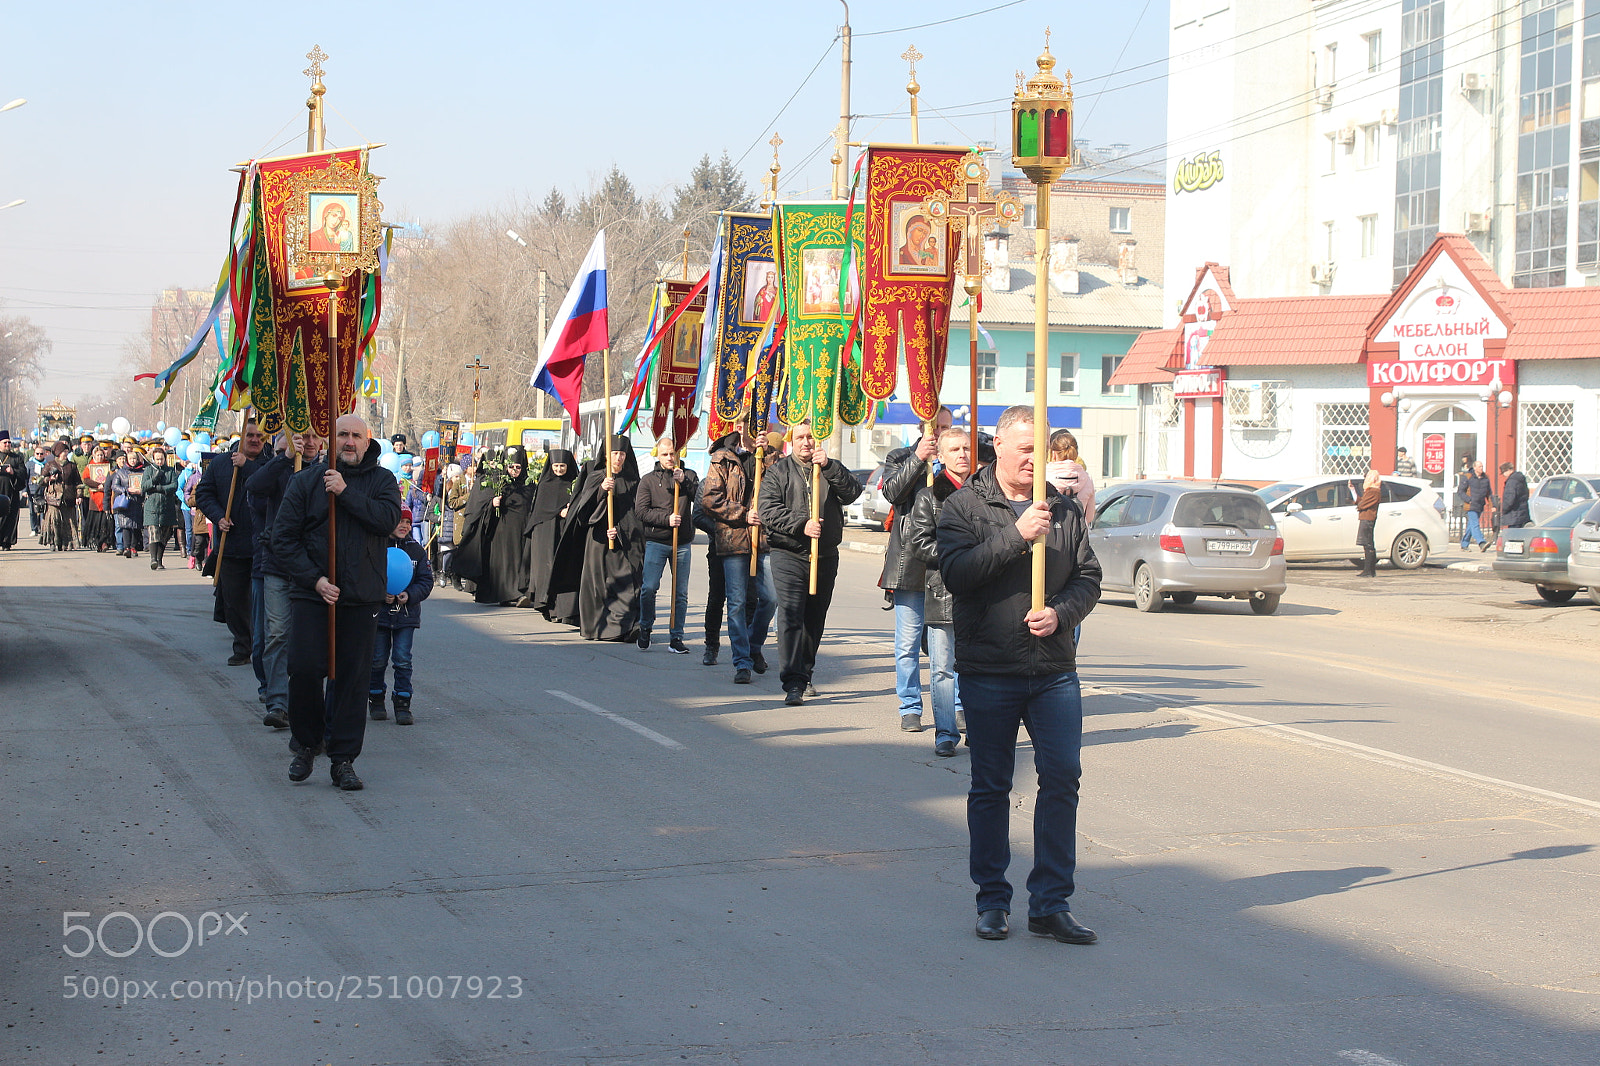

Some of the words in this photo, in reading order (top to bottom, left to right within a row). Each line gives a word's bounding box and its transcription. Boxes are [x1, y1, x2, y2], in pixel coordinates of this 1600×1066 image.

[1393, 317, 1490, 337] МЕБЕЛЬНЫЙ
[1414, 343, 1468, 357] САЛОН
[1372, 360, 1506, 384] КОМФОРТ
[1426, 451, 1443, 460] 9-18
